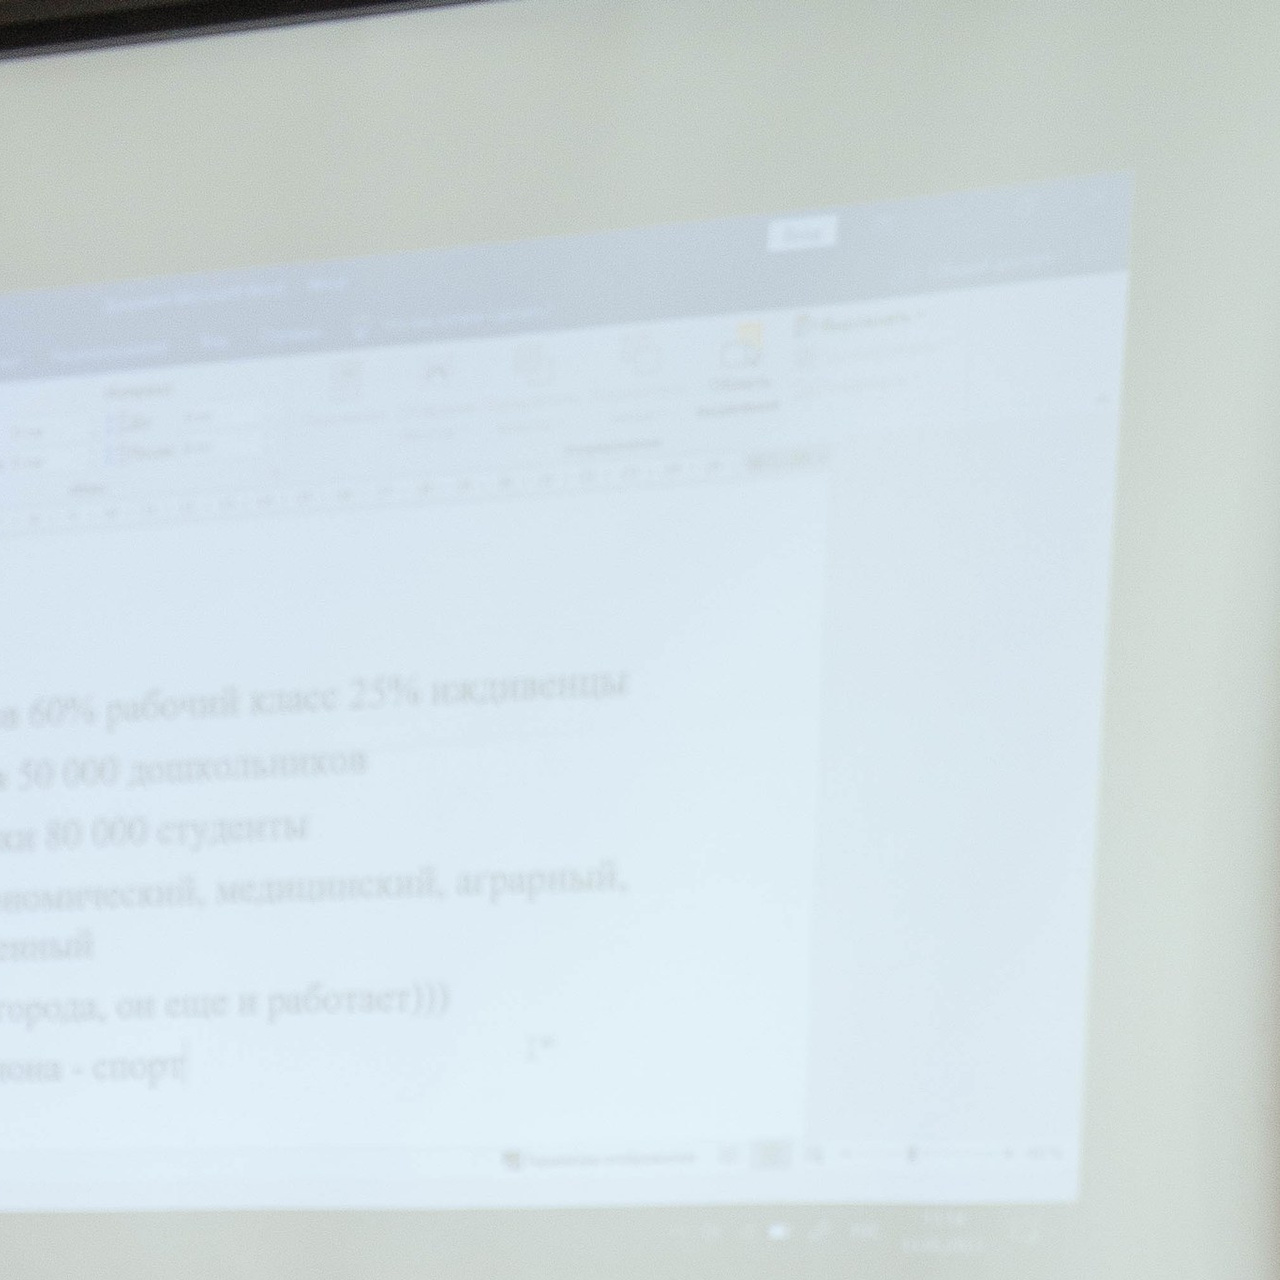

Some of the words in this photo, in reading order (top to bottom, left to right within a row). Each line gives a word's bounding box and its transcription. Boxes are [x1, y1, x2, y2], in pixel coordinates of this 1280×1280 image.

[27, 694, 97, 728] 60%
[105, 683, 241, 733] рабочий
[249, 685, 338, 716] класс
[347, 673, 420, 713] 25%
[429, 669, 631, 707] иждивенцы
[18, 757, 56, 791] 50
[61, 754, 121, 789] 000
[126, 749, 370, 790] дошкольников
[44, 817, 83, 851] 80
[90, 814, 149, 848] 000
[155, 812, 310, 852] студенты
[216, 863, 446, 908] медицинский,
[114, 993, 156, 1020] он
[163, 992, 228, 1023] еще
[238, 991, 257, 1017] и
[266, 980, 452, 1026] работает)))
[91, 1053, 187, 1091] спорт
